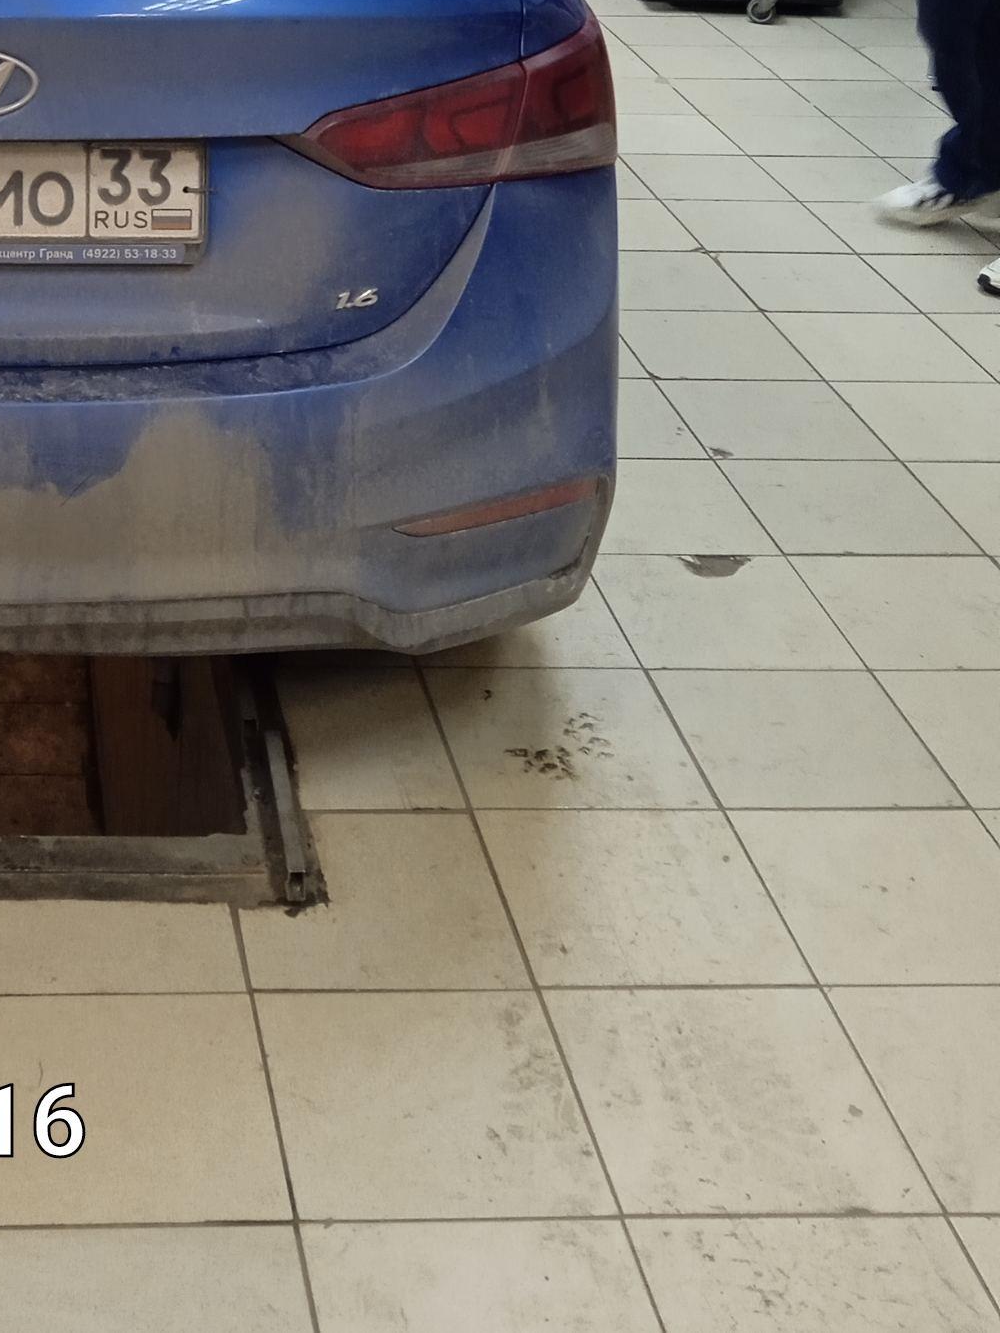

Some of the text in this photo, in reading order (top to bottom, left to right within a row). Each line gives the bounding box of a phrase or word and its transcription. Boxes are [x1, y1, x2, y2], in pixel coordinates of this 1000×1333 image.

[97, 149, 172, 206] 33
[93, 210, 148, 229] RUS
[39, 248, 74, 260] Гранд
[82, 247, 121, 260] (4922)
[124, 248, 177, 259] 53-18-33
[335, 288, 379, 310] 1.6
